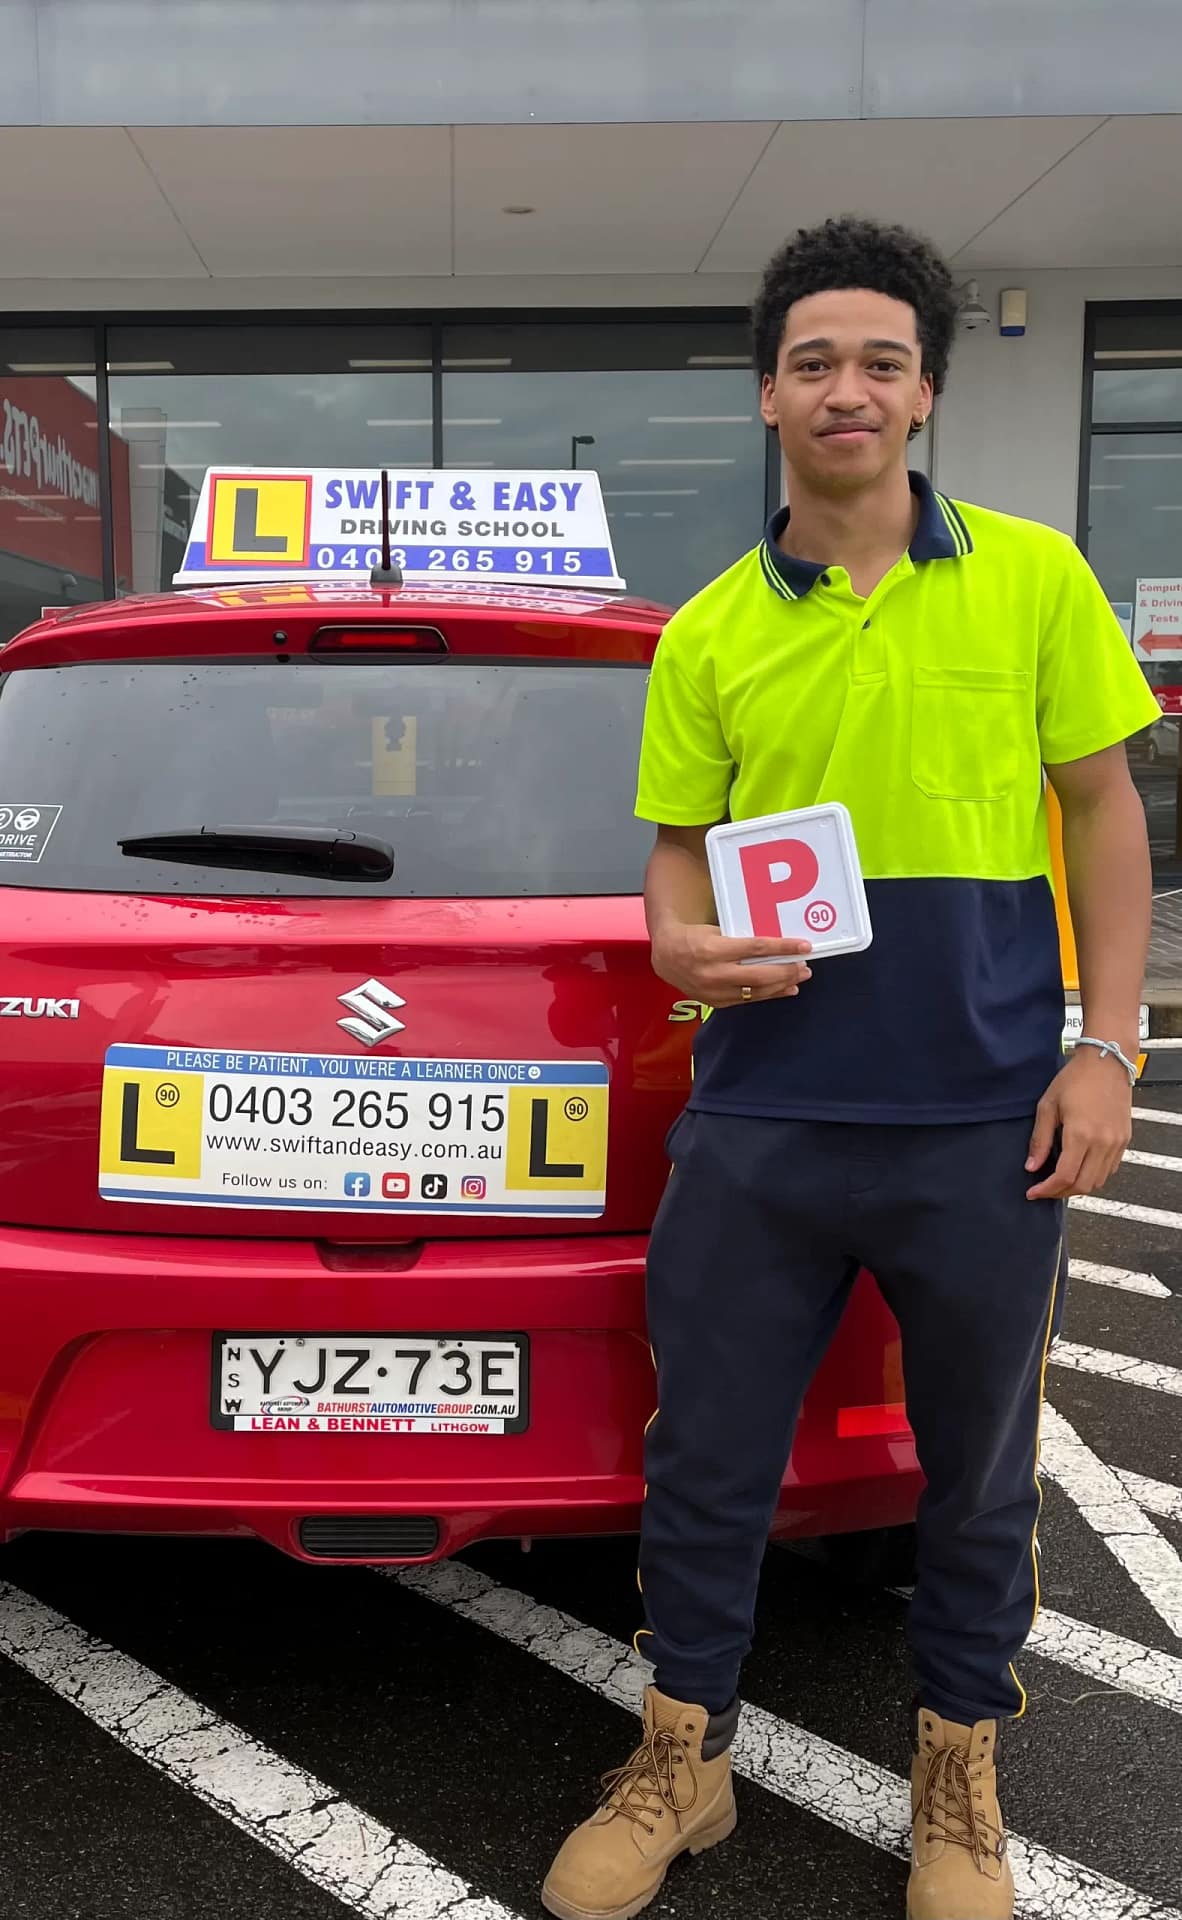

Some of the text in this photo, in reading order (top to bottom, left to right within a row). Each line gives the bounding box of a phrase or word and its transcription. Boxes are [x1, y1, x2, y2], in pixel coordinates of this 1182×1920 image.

[450, 480, 476, 510] &
[493, 482, 582, 511] EASY
[232, 488, 288, 552] L
[340, 519, 565, 537] DRIVING SCHOOL
[317, 547, 581, 572] 0403 265 915
[1140, 599, 1148, 607] &
[1149, 614, 1179, 623] Tests
[739, 838, 819, 938] P
[810, 909, 829, 924] 90
[1067, 1018, 1083, 1028] REV
[166, 1052, 526, 1080] PLEASE BE PATIENT, YOU WERE A LEARNER ONCE
[159, 1089, 176, 1101] 90
[208, 1083, 505, 1132] 0403 265 915
[569, 1103, 585, 1115] 90
[120, 1082, 175, 1165] L
[206, 1133, 502, 1160] www.swiftandeasy.com.au
[528, 1098, 585, 1178] L
[222, 1172, 272, 1188] Follow
[279, 1177, 297, 1188] us
[303, 1178, 328, 1190] on:
[317, 1401, 515, 1415] BATHURSTAUTOMOTIVEGROUP.COM.AU
[251, 1417, 489, 1432] LEAN & BENNETT LITHGOW
